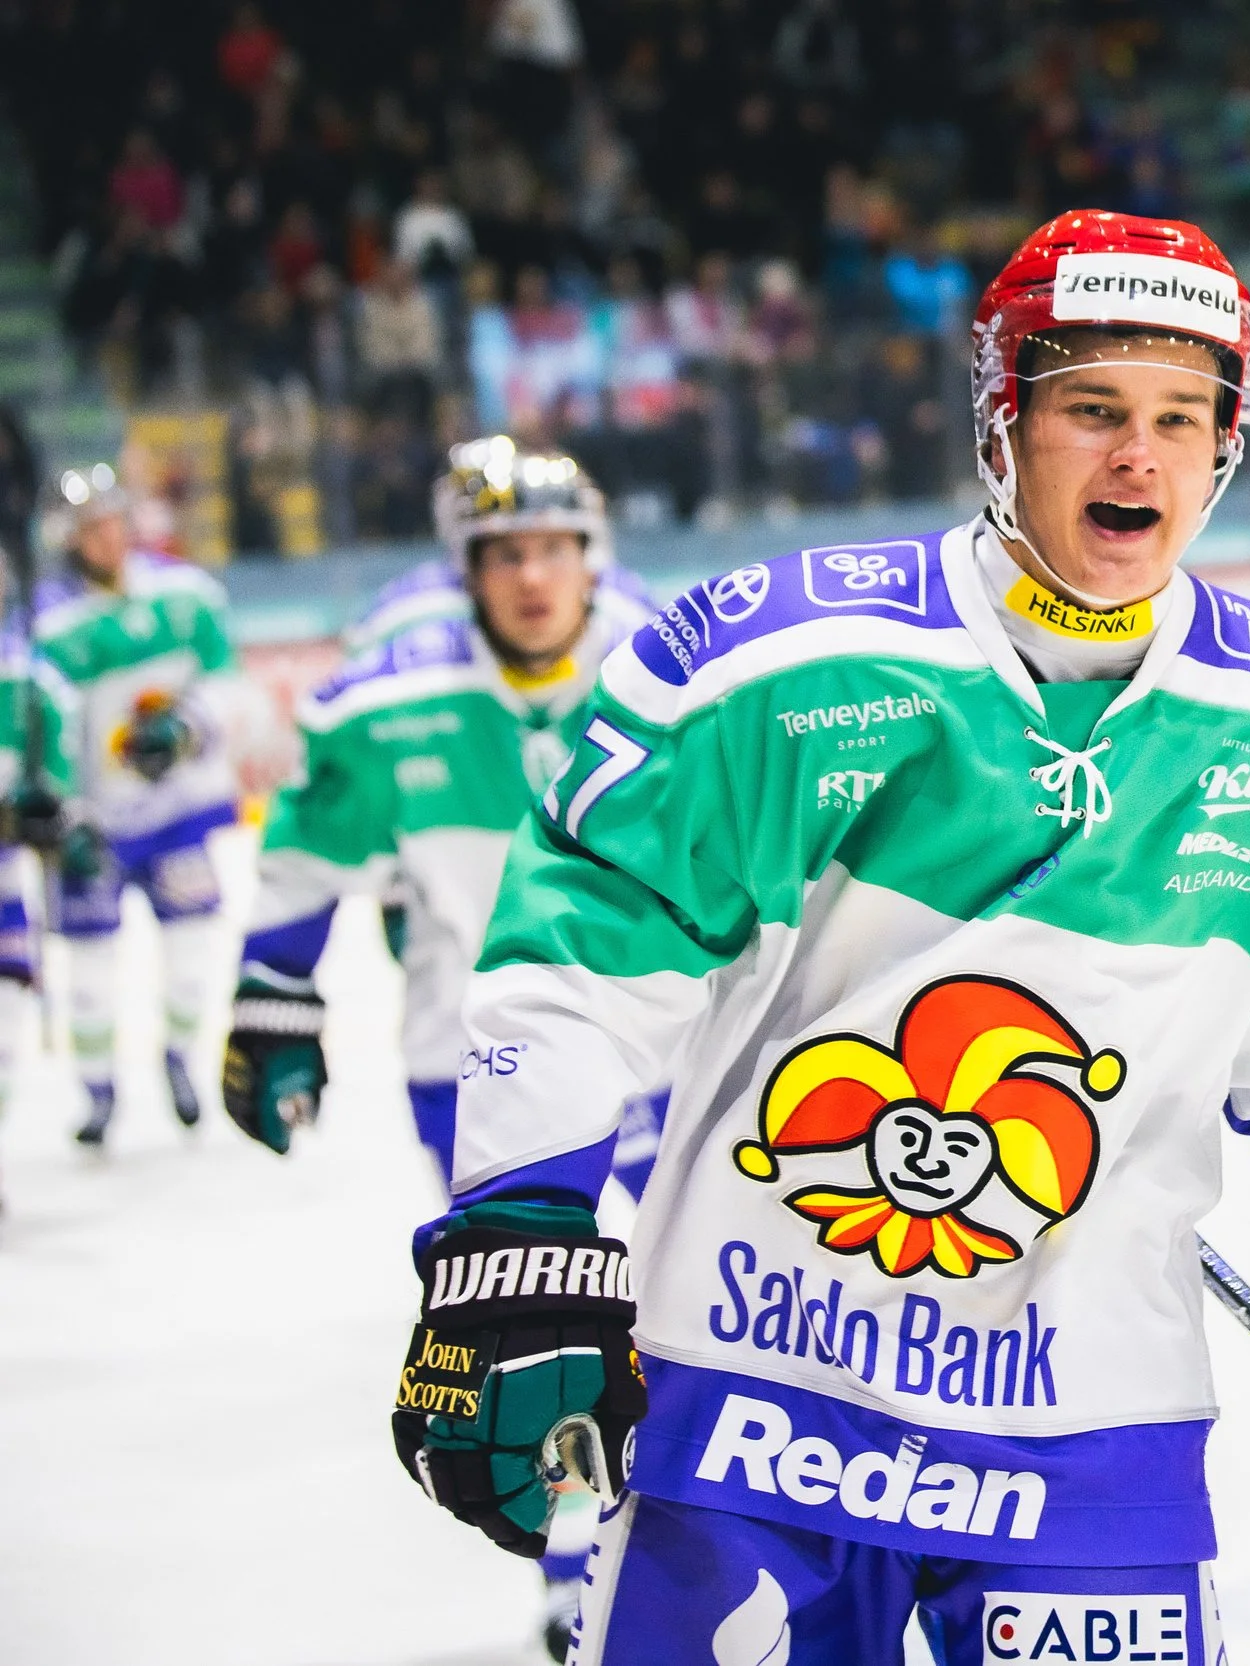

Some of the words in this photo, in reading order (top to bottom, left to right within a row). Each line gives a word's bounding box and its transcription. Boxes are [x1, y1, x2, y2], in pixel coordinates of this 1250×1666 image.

[1028, 593, 1136, 633] HELSINKI
[776, 692, 937, 737] Terveystalo
[837, 735, 887, 751] SPORT
[708, 1240, 880, 1385] Saldo
[894, 1291, 1058, 1408] Bank
[694, 1393, 1048, 1541] Redan
[986, 1605, 1184, 1662] CABLE
